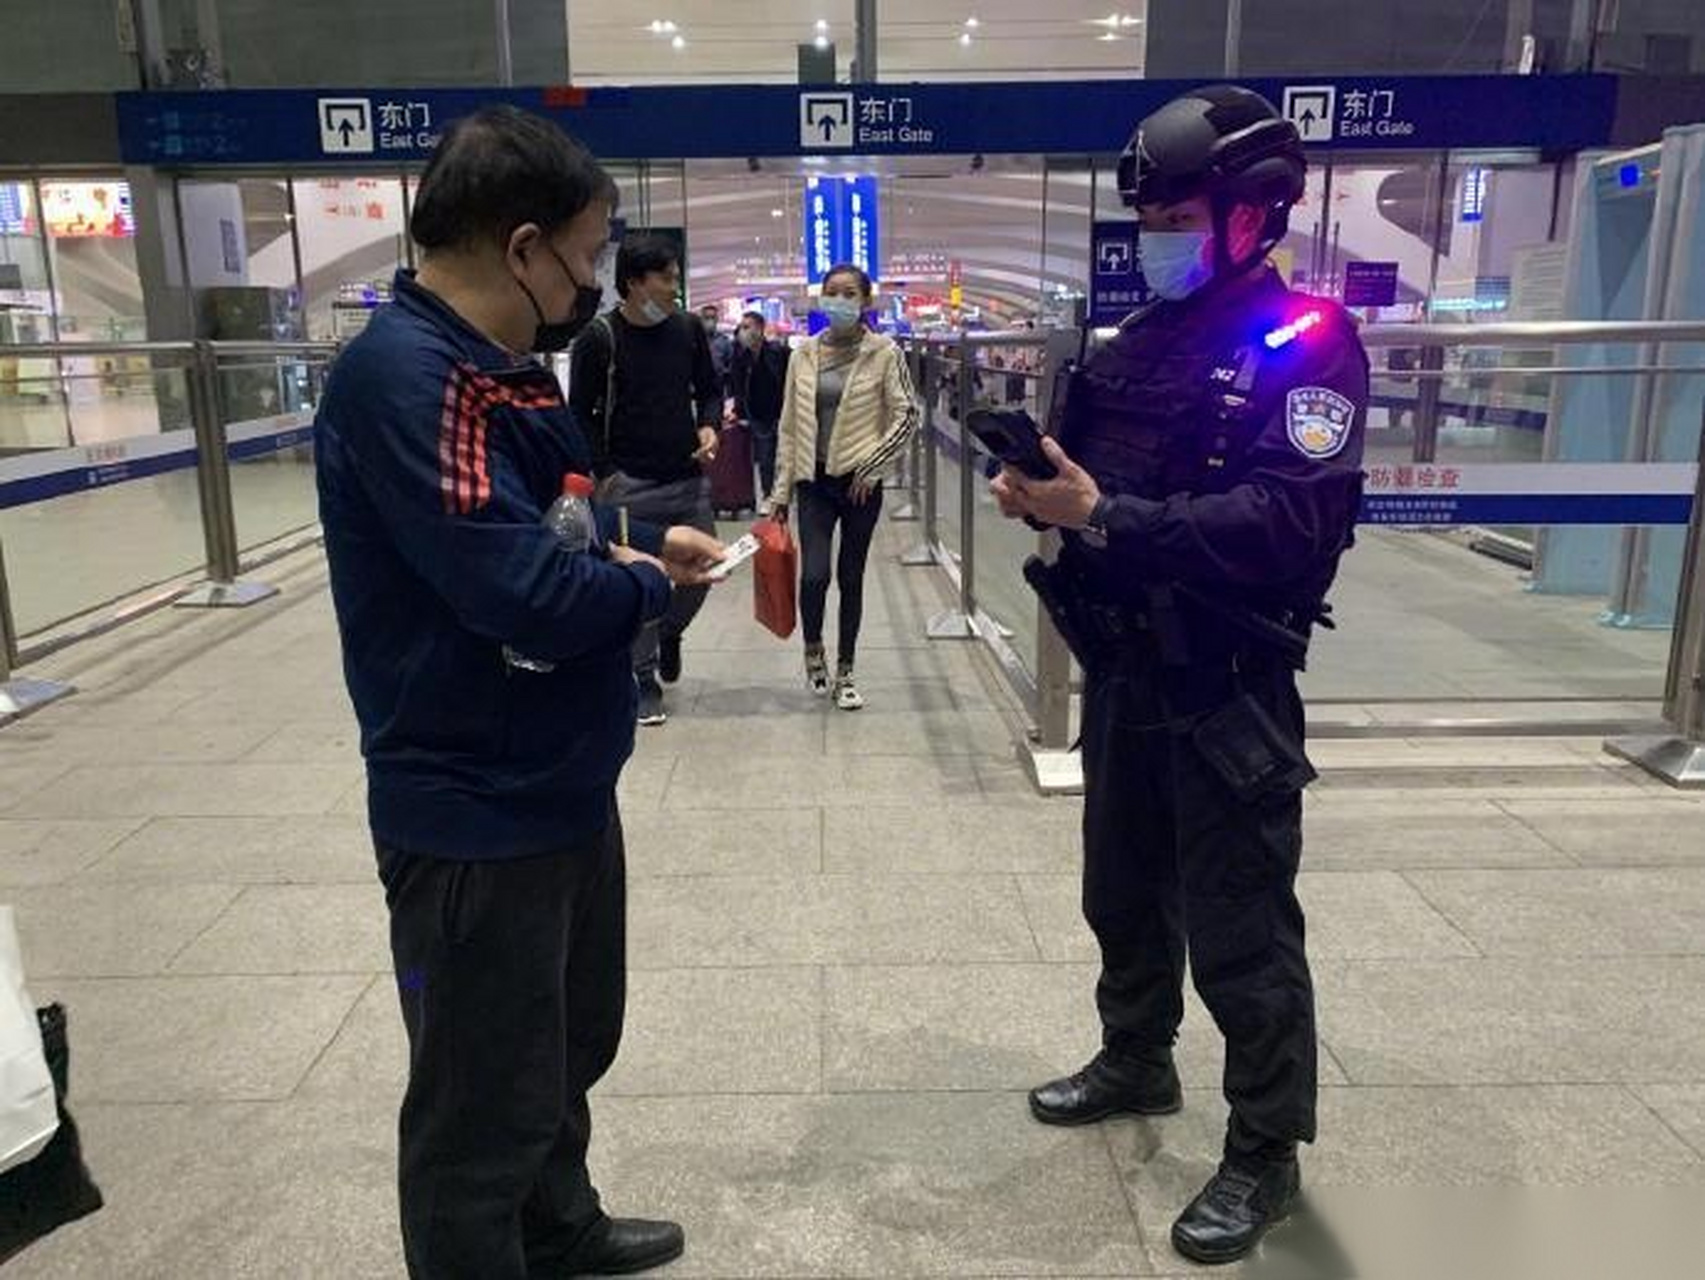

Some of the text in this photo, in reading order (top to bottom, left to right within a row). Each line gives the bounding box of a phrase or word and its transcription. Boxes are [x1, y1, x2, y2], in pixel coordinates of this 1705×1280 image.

[860, 97, 912, 124] 东门
[1343, 89, 1395, 119] 东门
[378, 101, 430, 129] 东门
[859, 127, 933, 142] East Gate
[1340, 120, 1414, 136] East Gate
[380, 132, 413, 148] East
